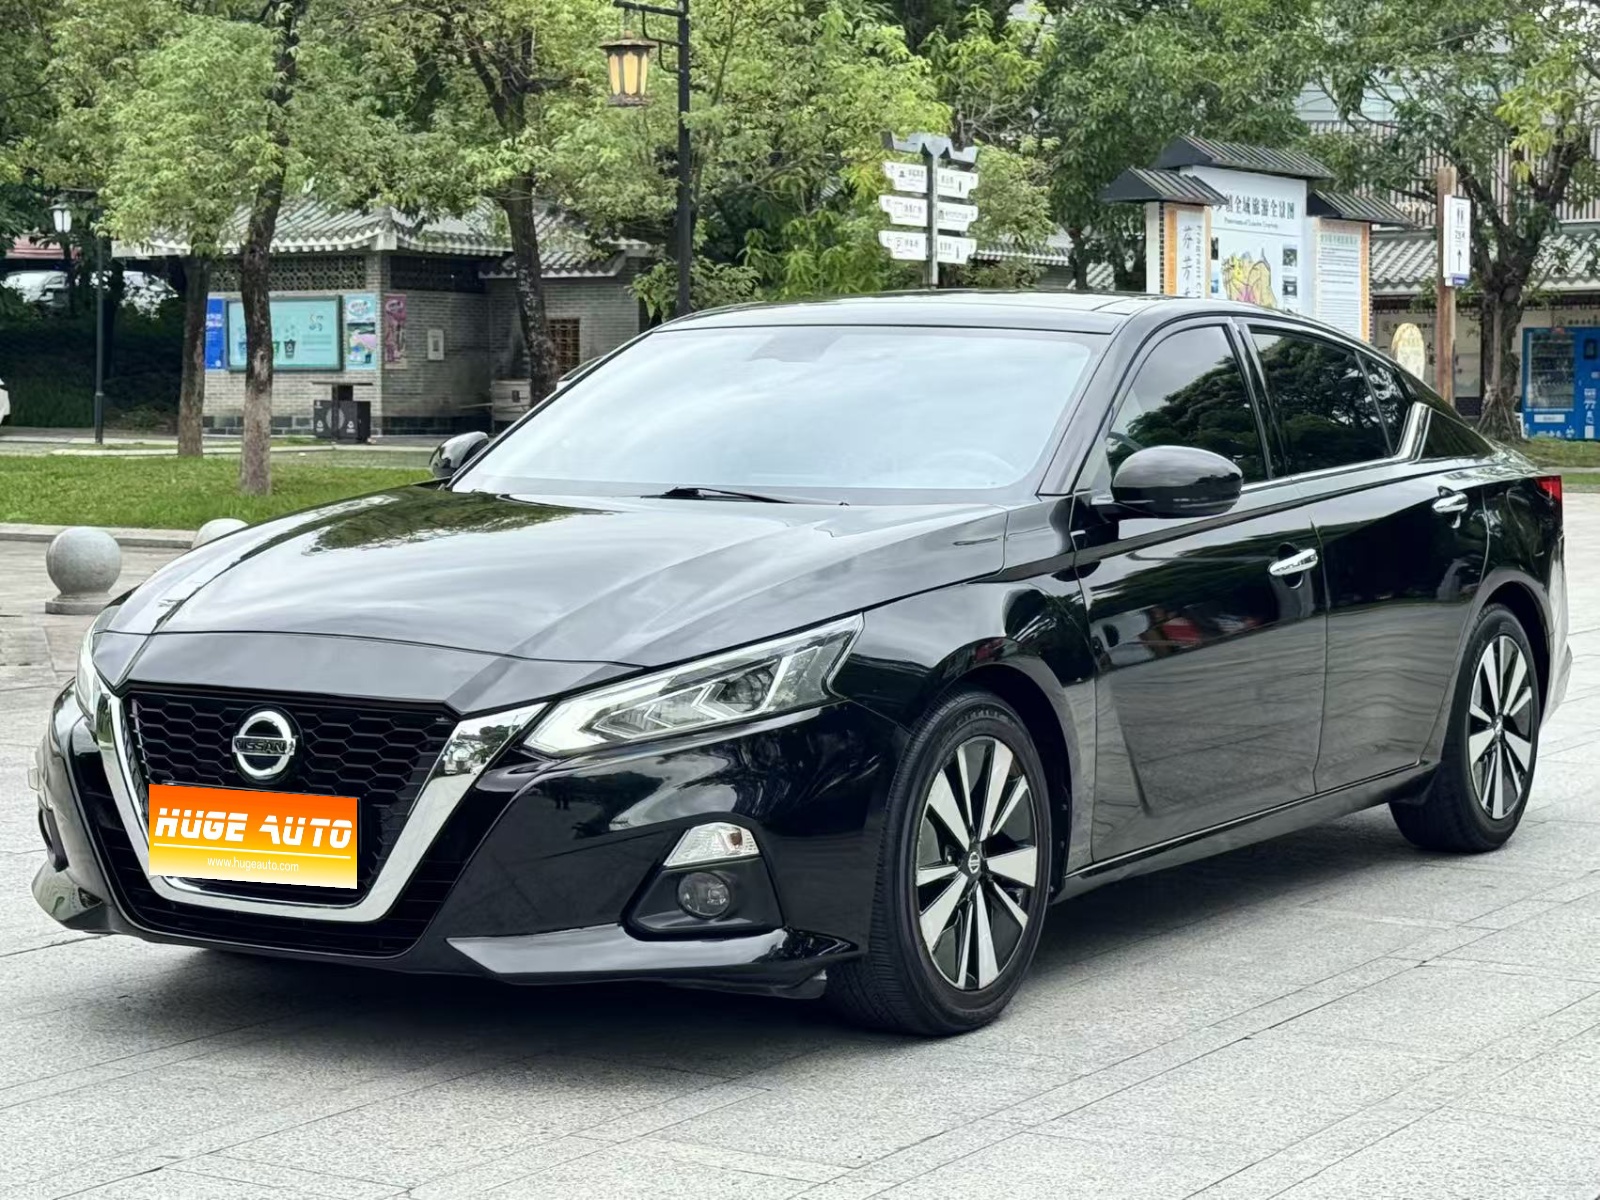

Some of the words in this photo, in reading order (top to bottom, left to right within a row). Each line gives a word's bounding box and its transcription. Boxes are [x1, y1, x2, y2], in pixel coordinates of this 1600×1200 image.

[1216, 193, 1294, 219] 镇全域旅游全景图
[235, 740, 286, 753] NISSAN
